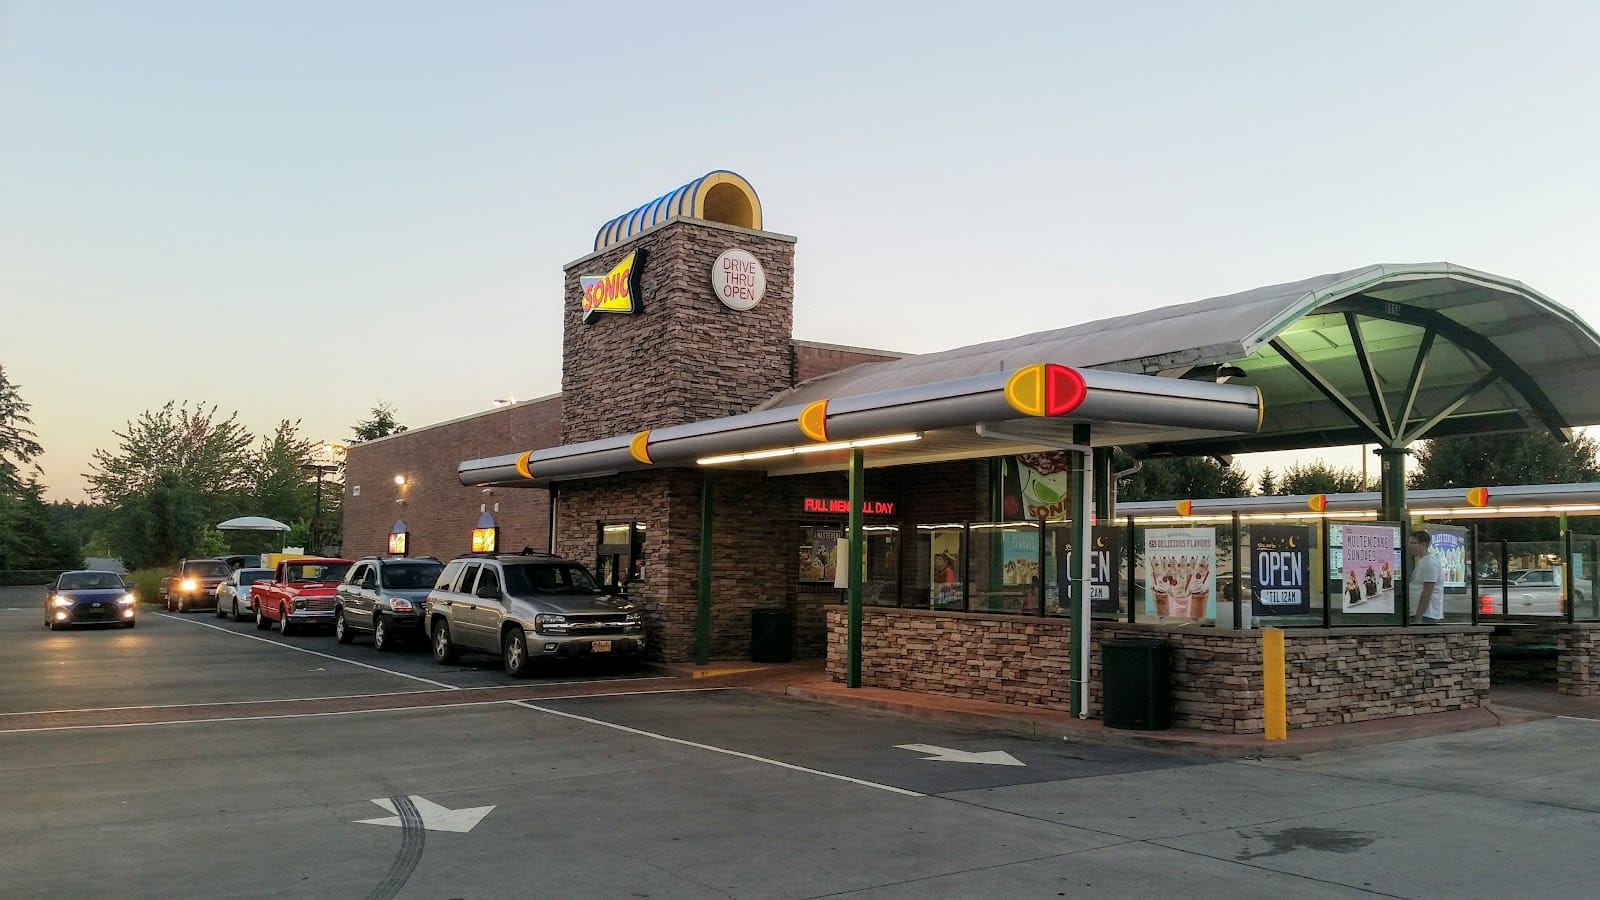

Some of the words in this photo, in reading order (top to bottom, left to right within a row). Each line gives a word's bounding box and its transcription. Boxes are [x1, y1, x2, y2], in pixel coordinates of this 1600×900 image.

[723, 258, 756, 274] DRIVE
[724, 271, 754, 287] THRU
[583, 269, 629, 311] SONIC
[723, 286, 755, 301] OPEN
[804, 498, 828, 512] FULL
[829, 499, 850, 512] MEN
[862, 502, 874, 513] LL
[875, 502, 894, 514] DAY
[1157, 539, 1186, 548] DELICIOUS
[1187, 539, 1211, 548] FLAVORS
[1258, 551, 1302, 586] OPEN
[1090, 587, 1103, 598] 2AM
[1281, 591, 1296, 603] 12AM
